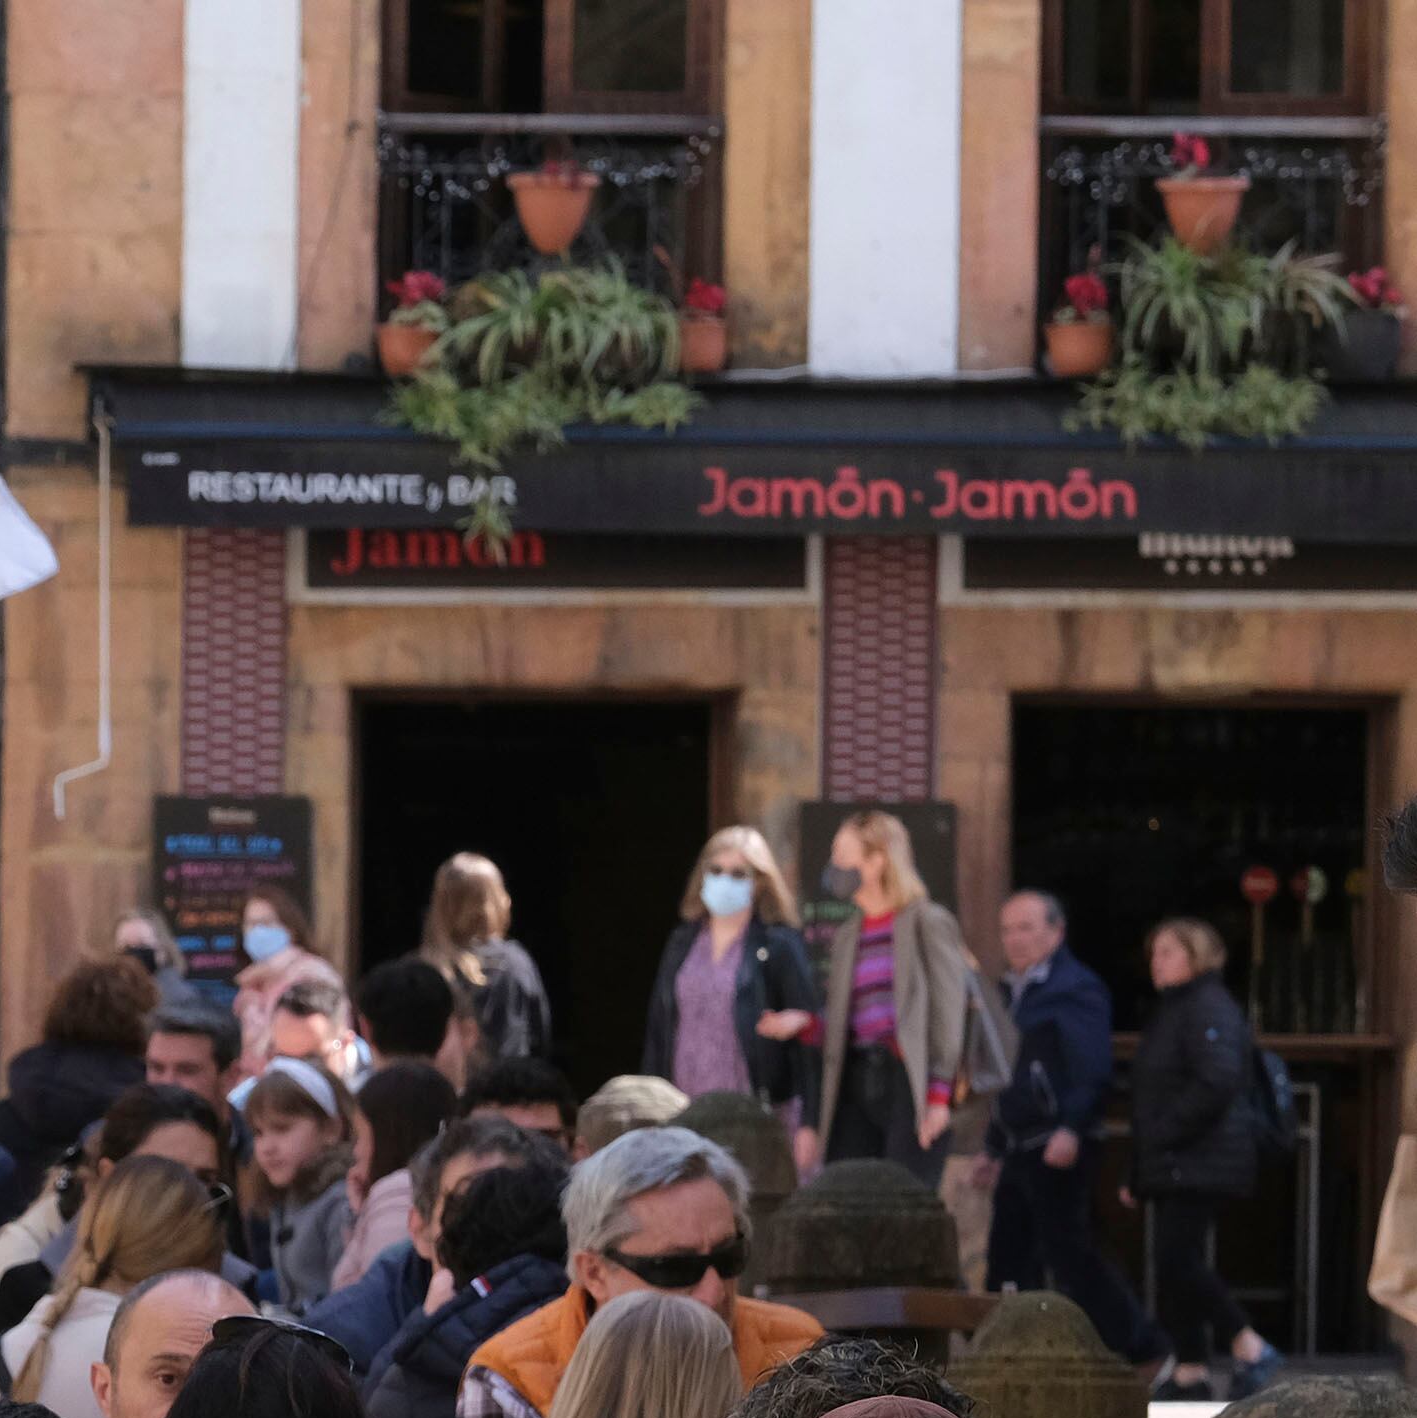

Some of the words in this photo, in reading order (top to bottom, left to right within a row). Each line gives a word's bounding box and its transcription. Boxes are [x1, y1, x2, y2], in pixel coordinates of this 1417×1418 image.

[188, 470, 423, 505] RESTAURANTE
[447, 475, 516, 506] BAR
[697, 465, 905, 518] Jamón
[929, 467, 1138, 518] Jamón
